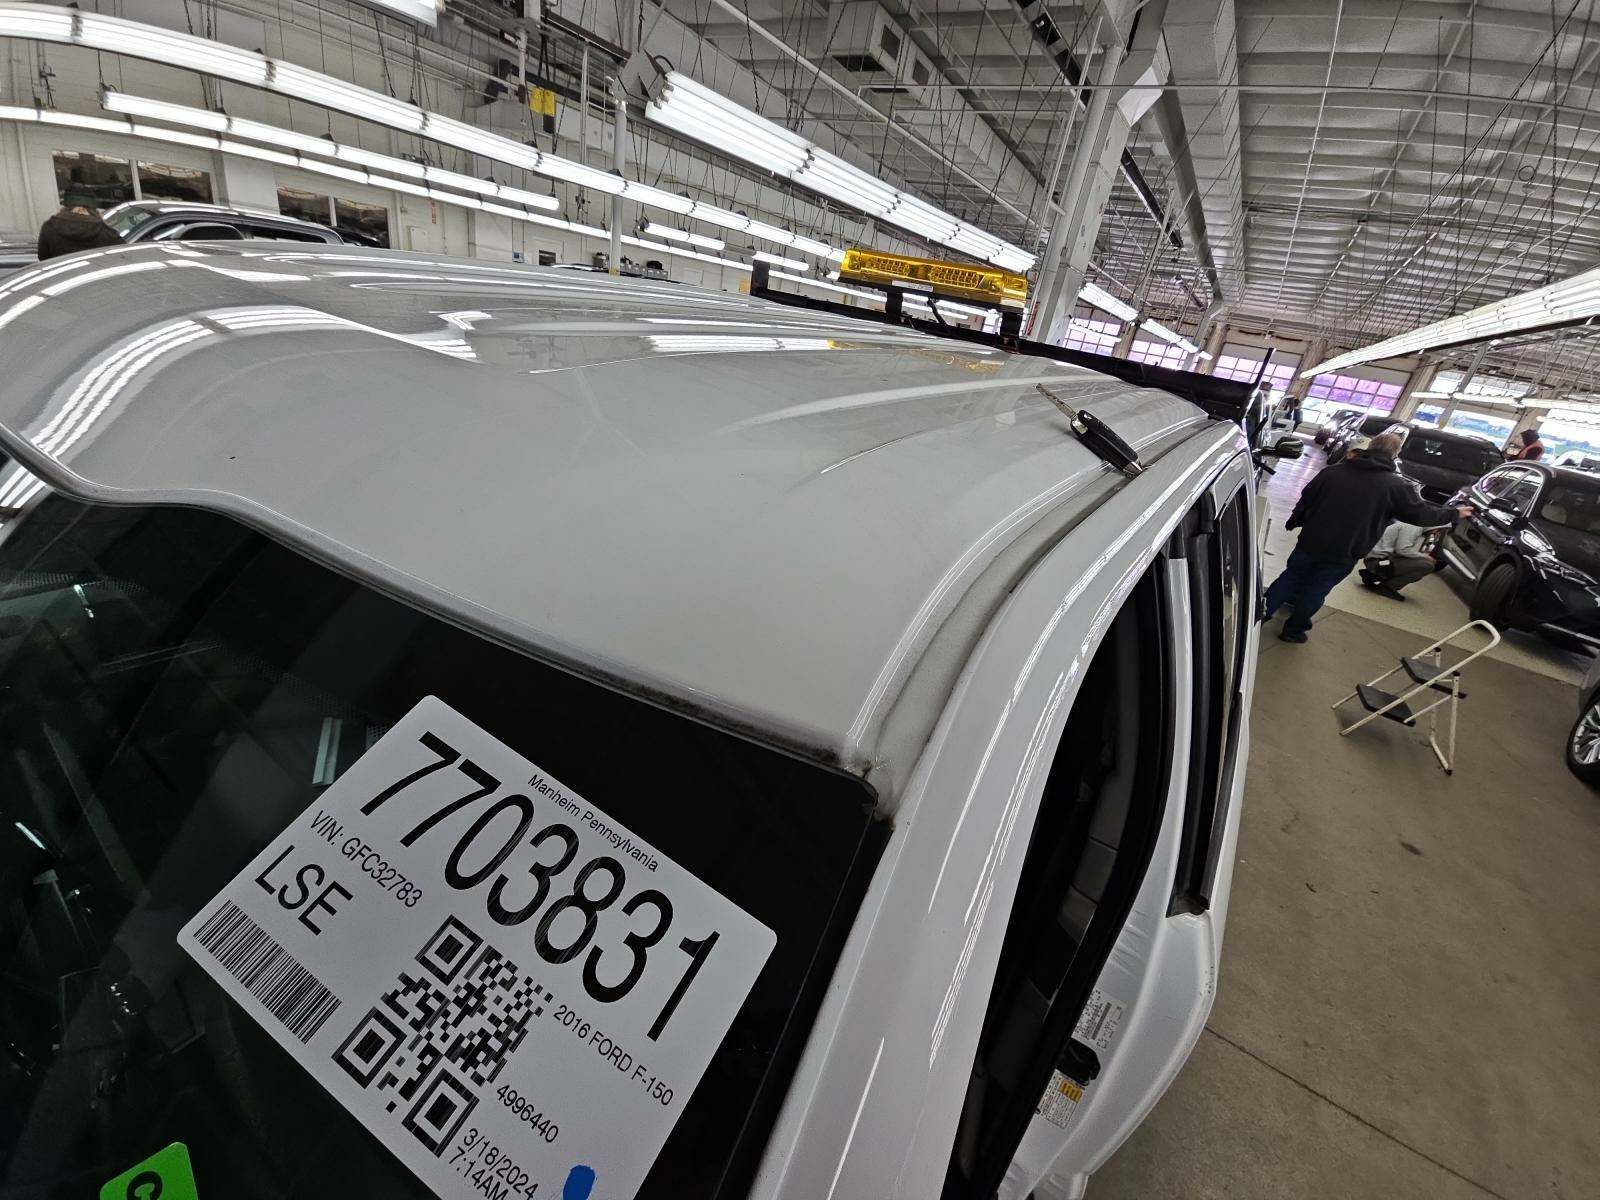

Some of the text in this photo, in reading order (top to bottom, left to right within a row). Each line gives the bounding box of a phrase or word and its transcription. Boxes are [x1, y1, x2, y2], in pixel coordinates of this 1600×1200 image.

[310, 810, 423, 907] VIN: GFC32783
[527, 774, 659, 872] Manheim Pennsylvania
[254, 844, 354, 937] LSE
[360, 730, 721, 1042] 7703831
[553, 1004, 674, 1106] 2016 FORD F-150
[496, 1084, 559, 1143] 4996440
[449, 1146, 509, 1200] 7:14AM
[463, 1128, 539, 1200] 3/18/2024
